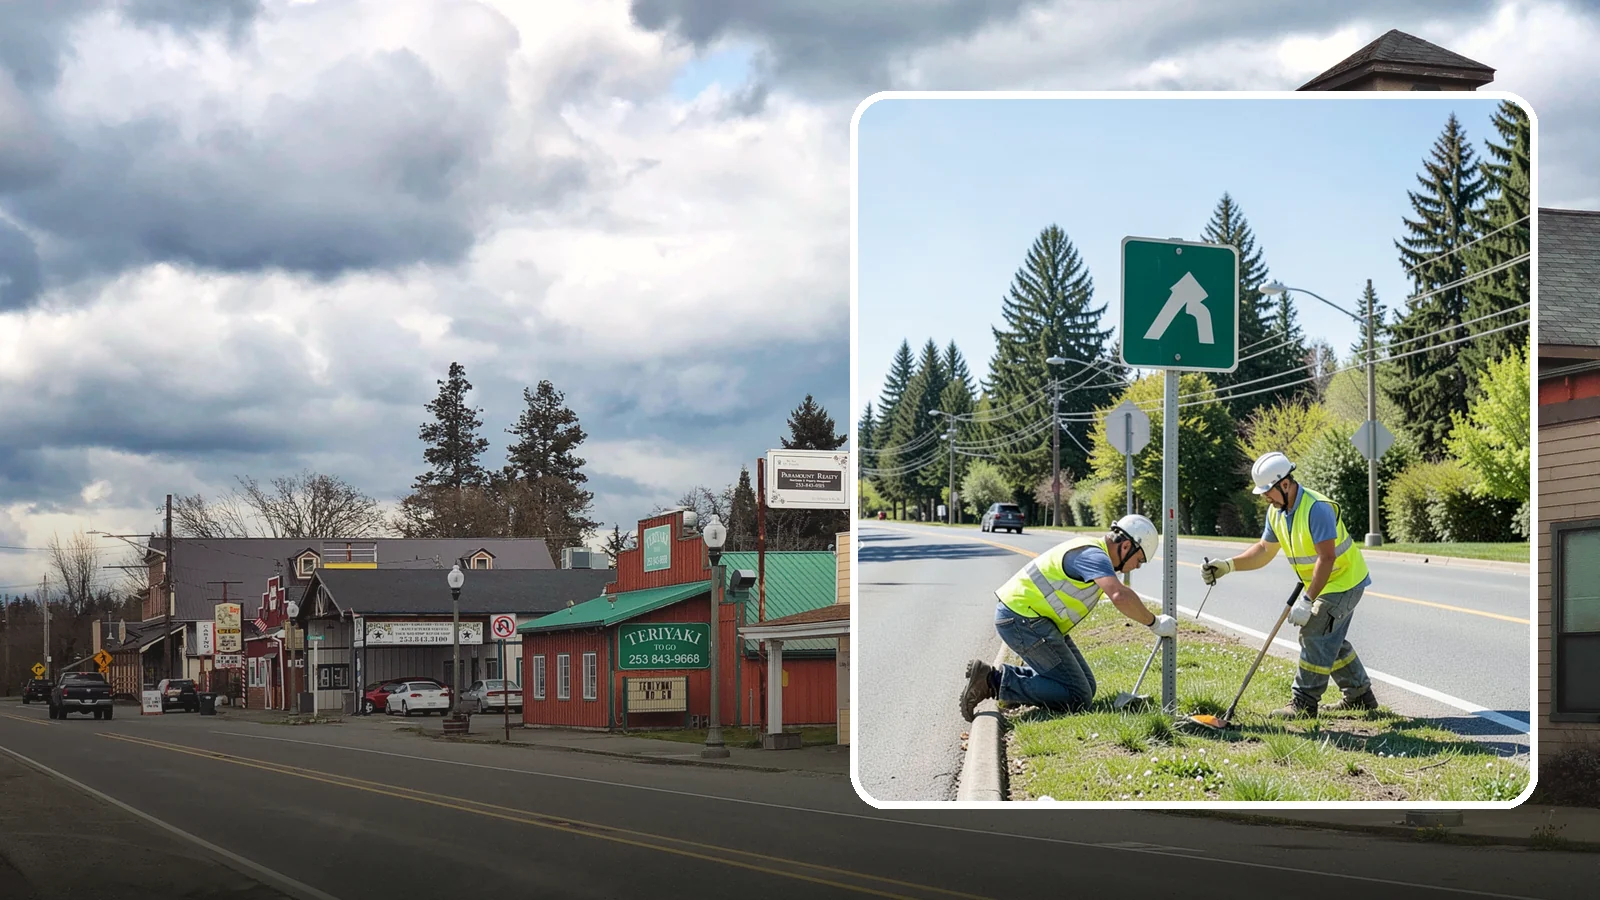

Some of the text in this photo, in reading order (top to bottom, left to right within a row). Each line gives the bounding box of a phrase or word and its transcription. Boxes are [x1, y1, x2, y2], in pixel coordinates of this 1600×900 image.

[781, 471, 839, 480] PARAMOUNT REALTY
[624, 627, 702, 646] TERIYAKI
[629, 653, 700, 664] 253 843-9668
